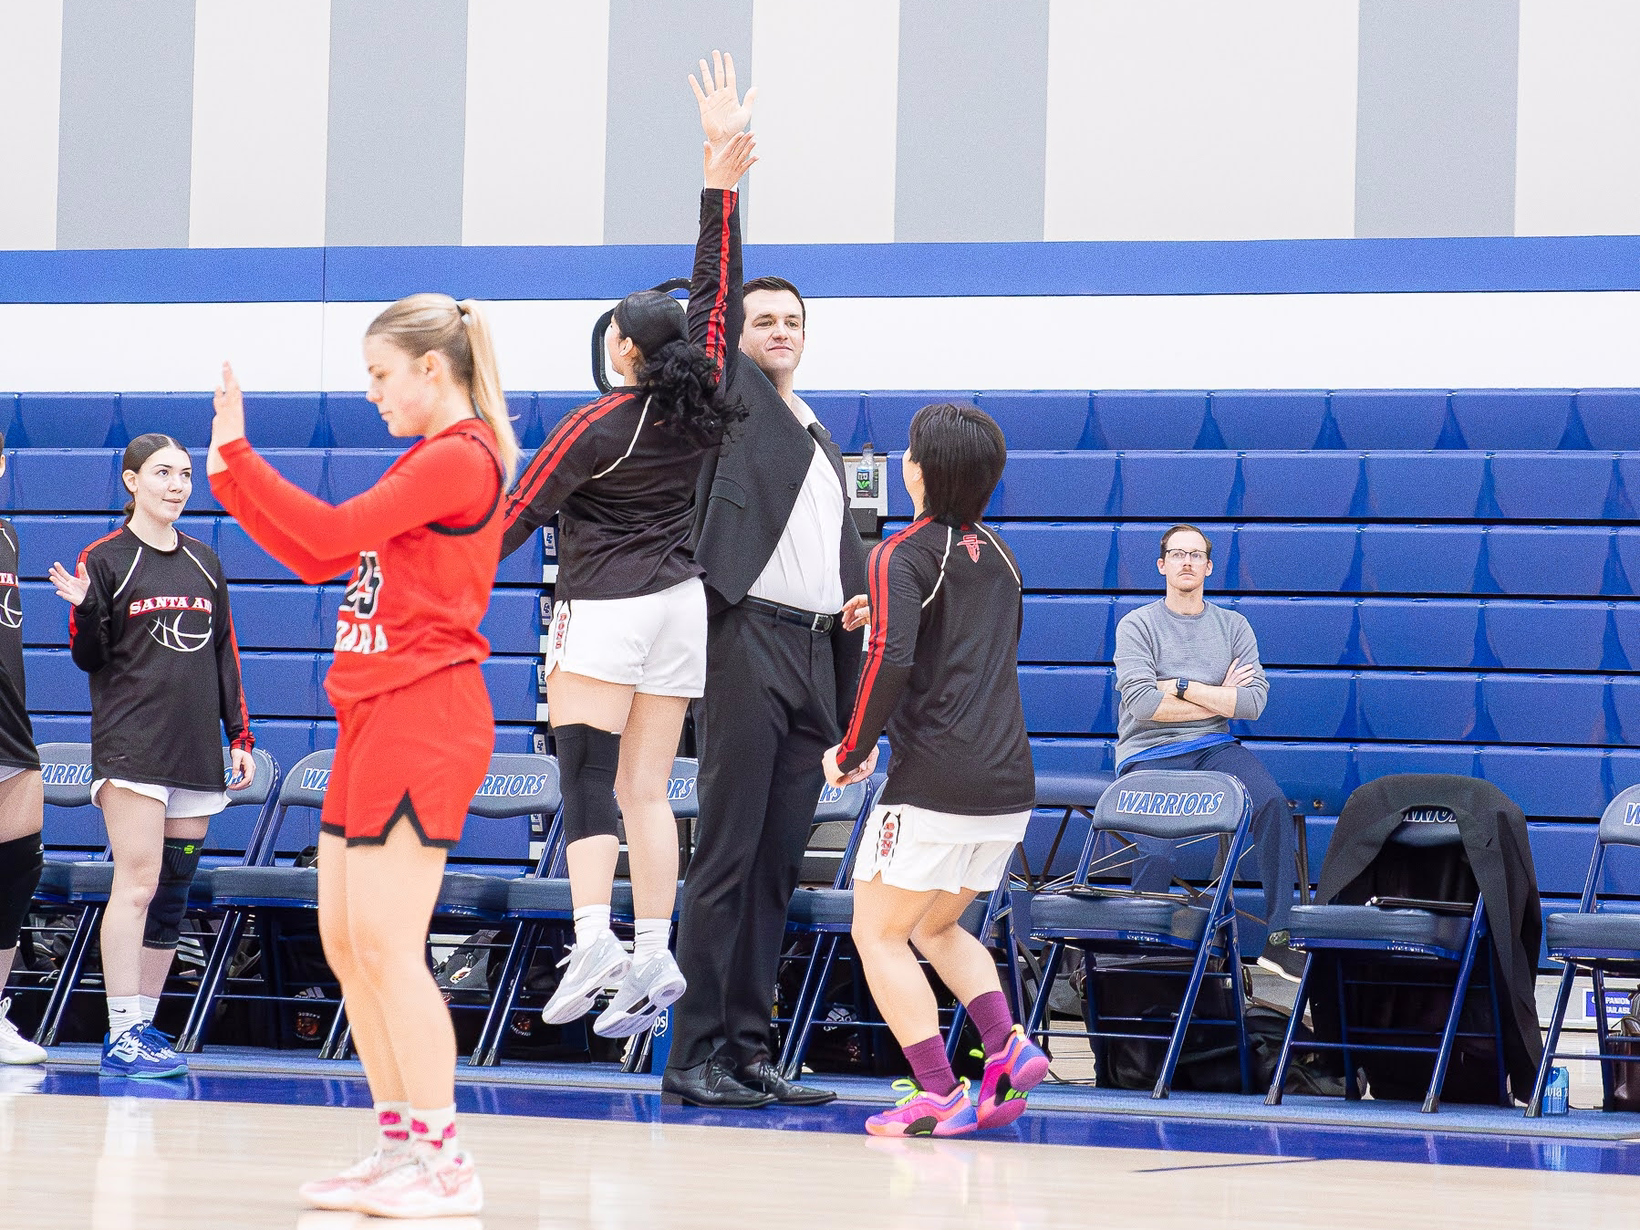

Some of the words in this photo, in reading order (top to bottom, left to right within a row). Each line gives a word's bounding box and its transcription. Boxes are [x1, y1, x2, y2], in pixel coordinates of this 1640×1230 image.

[129, 596, 189, 617] SANTA
[474, 774, 548, 796] RRIORS
[1116, 790, 1225, 816] WARRIORS
